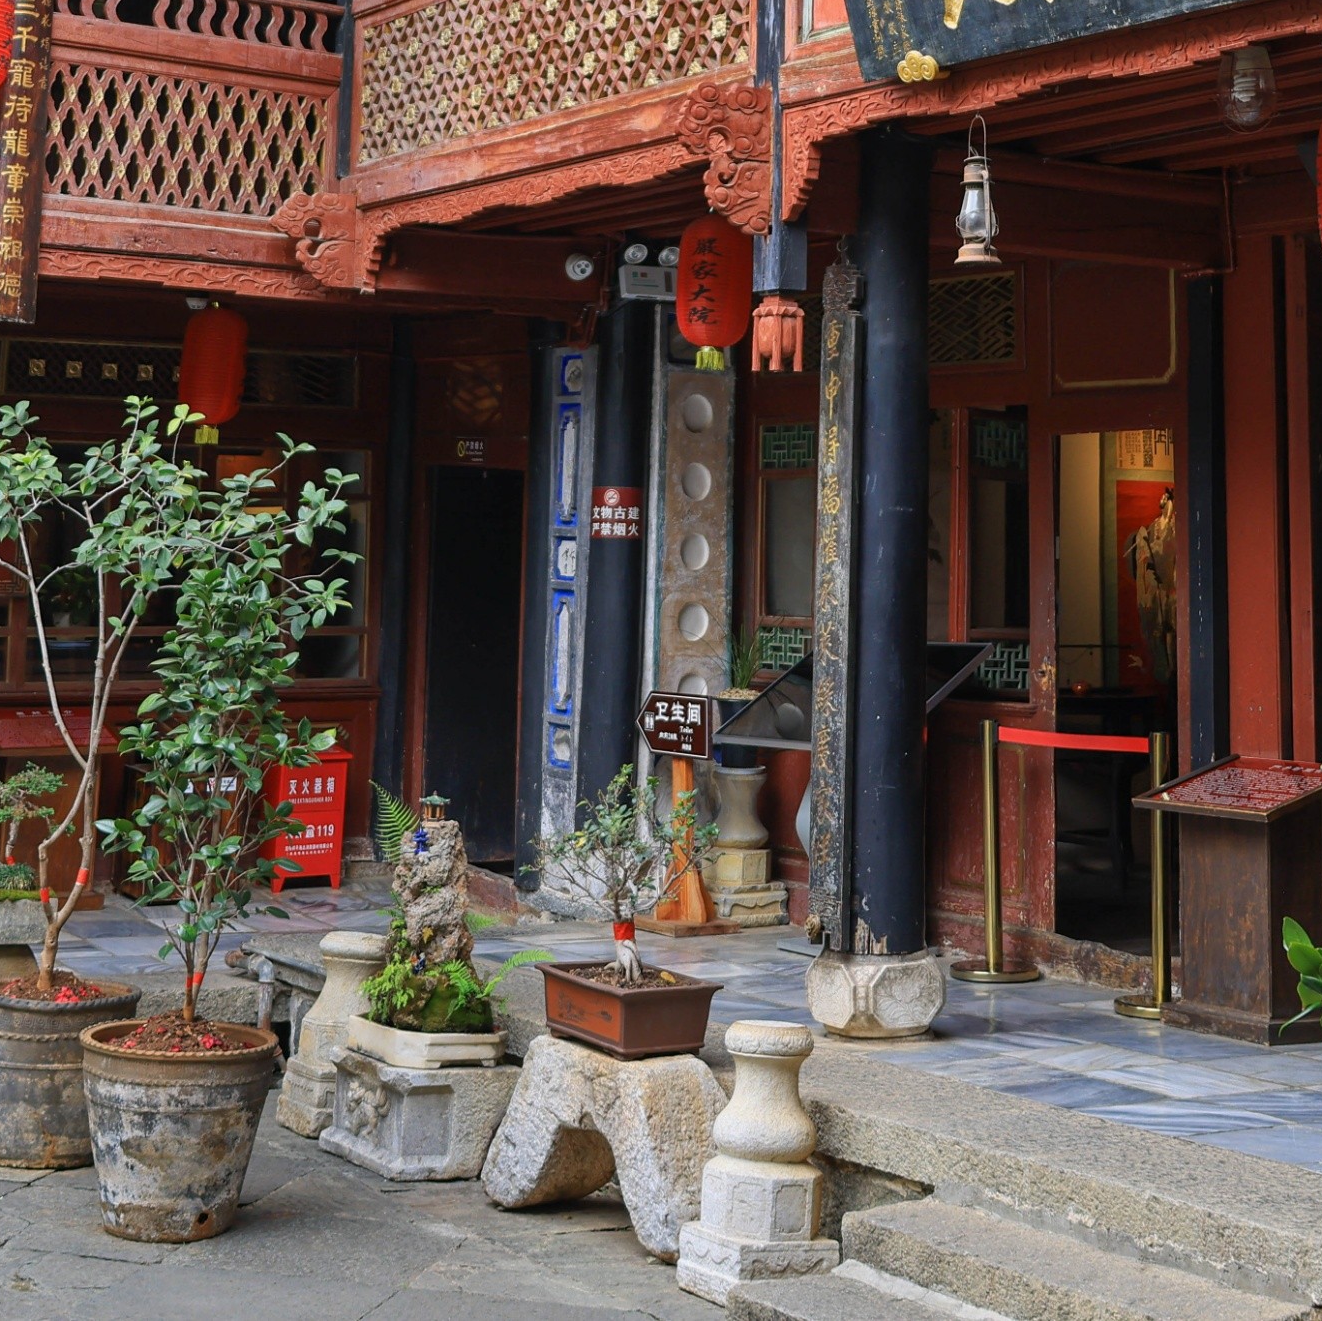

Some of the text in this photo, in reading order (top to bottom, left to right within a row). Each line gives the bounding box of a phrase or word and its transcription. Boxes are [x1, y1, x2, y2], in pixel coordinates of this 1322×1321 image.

[592, 505, 640, 520] 文物古建
[591, 522, 639, 537] 严禁烟火
[655, 701, 701, 726] 卫生间
[289, 776, 335, 795] 灭火器箱
[317, 823, 334, 837] 119
